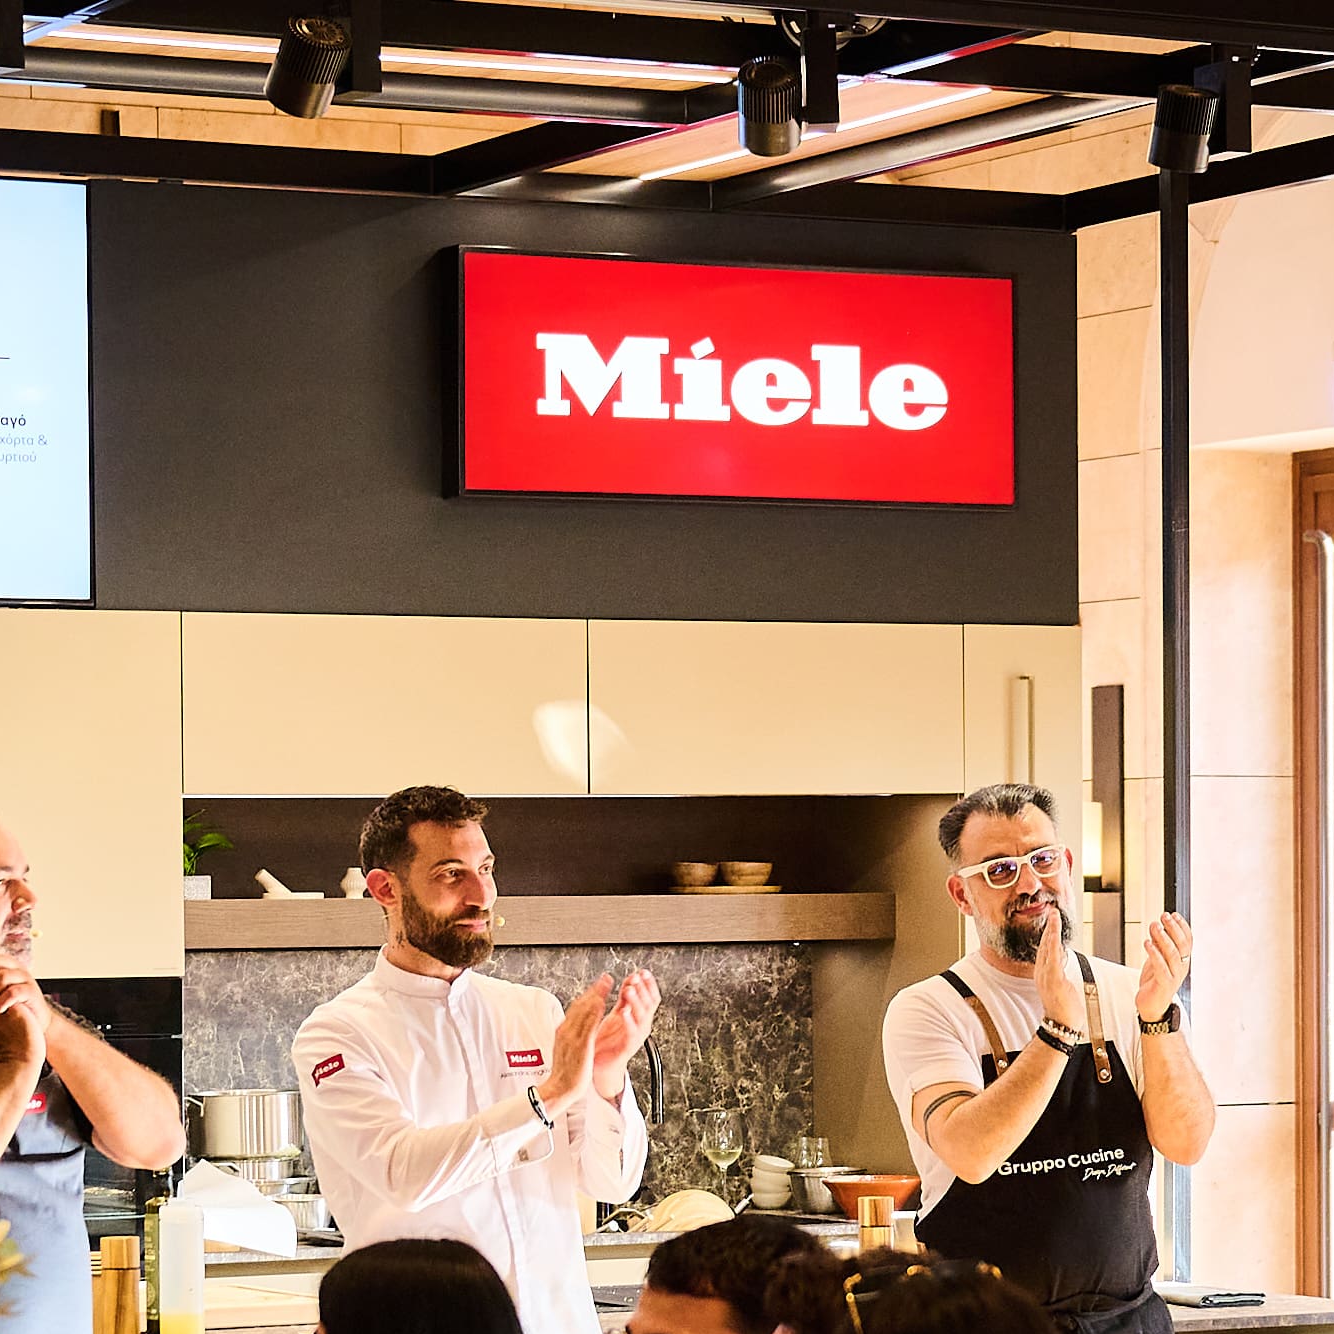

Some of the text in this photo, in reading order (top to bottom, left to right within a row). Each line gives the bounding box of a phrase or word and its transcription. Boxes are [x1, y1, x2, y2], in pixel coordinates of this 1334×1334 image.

[536, 332, 948, 431] Miele
[997, 1148, 1125, 1176] Gruppo Cucine
